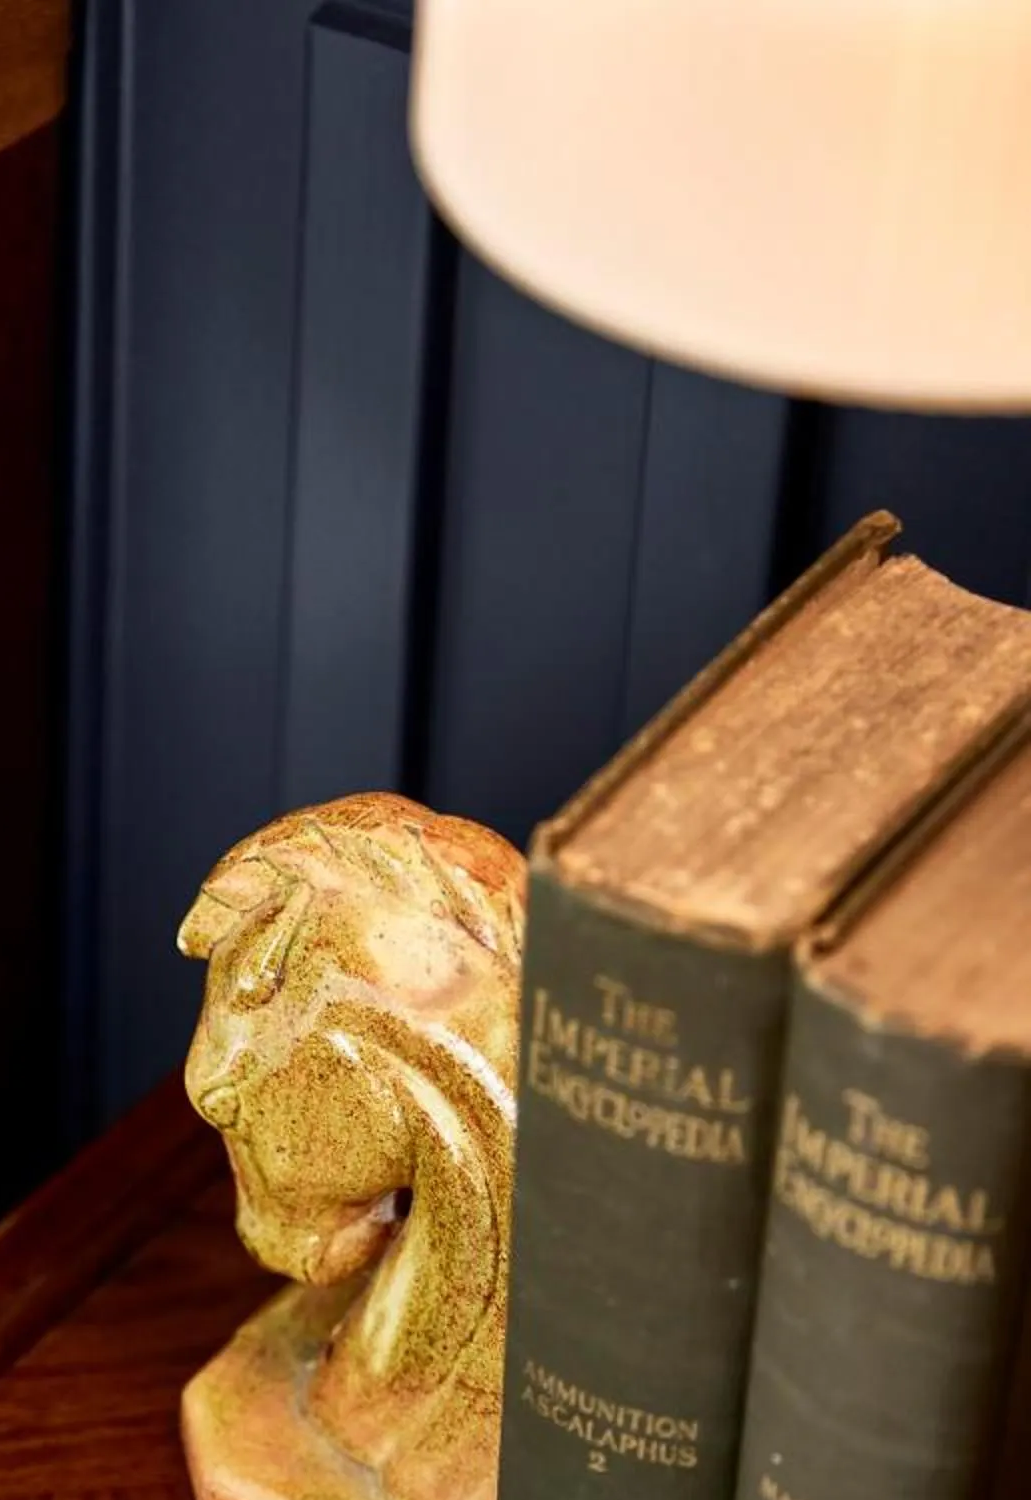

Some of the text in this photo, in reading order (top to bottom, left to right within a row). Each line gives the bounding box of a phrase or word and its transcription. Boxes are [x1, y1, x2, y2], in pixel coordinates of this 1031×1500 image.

[594, 973, 678, 1046] THE
[533, 988, 749, 1114] IMPERIAL
[782, 1094, 1005, 1233] IMPERIAL
[843, 1088, 931, 1170] THE
[521, 1385, 698, 1469] ASCALAPHUS
[523, 1360, 699, 1441] AMMUNITION
[587, 1450, 608, 1473] 2
